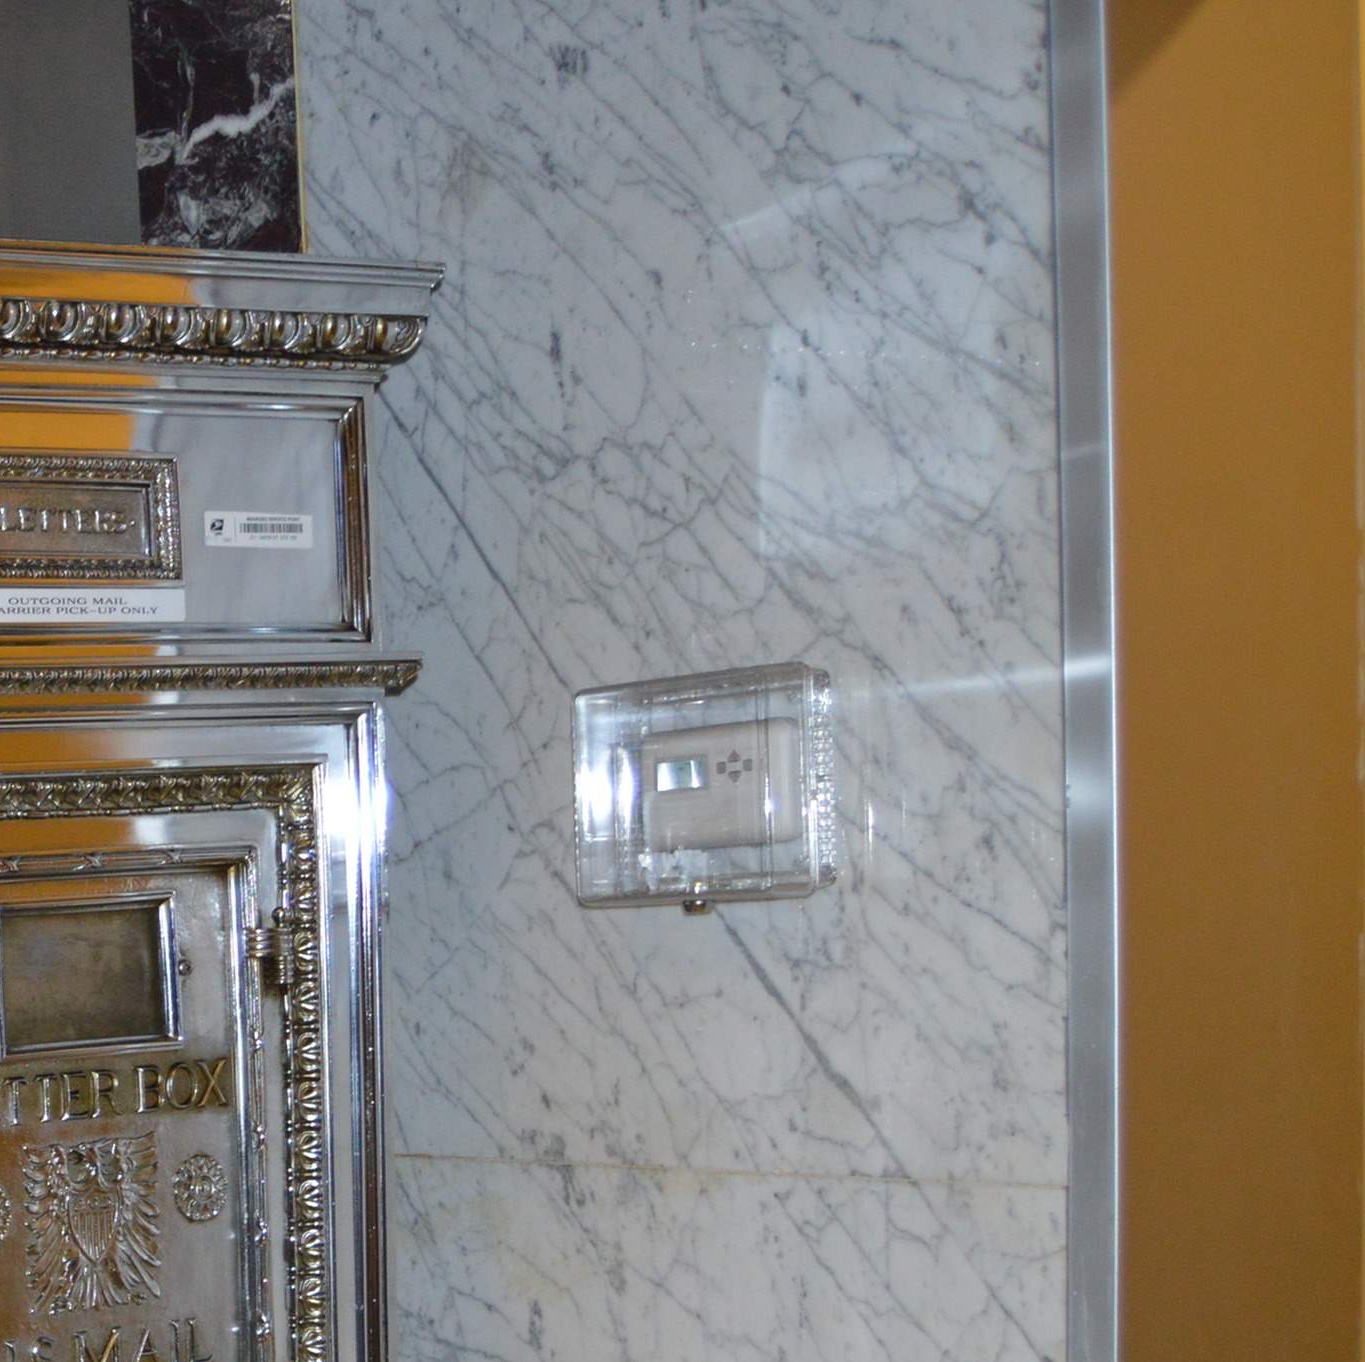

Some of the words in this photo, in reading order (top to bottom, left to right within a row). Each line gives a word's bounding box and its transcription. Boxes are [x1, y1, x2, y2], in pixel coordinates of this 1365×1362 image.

[7, 596, 88, 606] OUTGOING
[92, 596, 128, 606] MAIL
[55, 606, 119, 615] PICK-UP
[120, 606, 159, 615] ONLY
[133, 1057, 228, 1114] BOX
